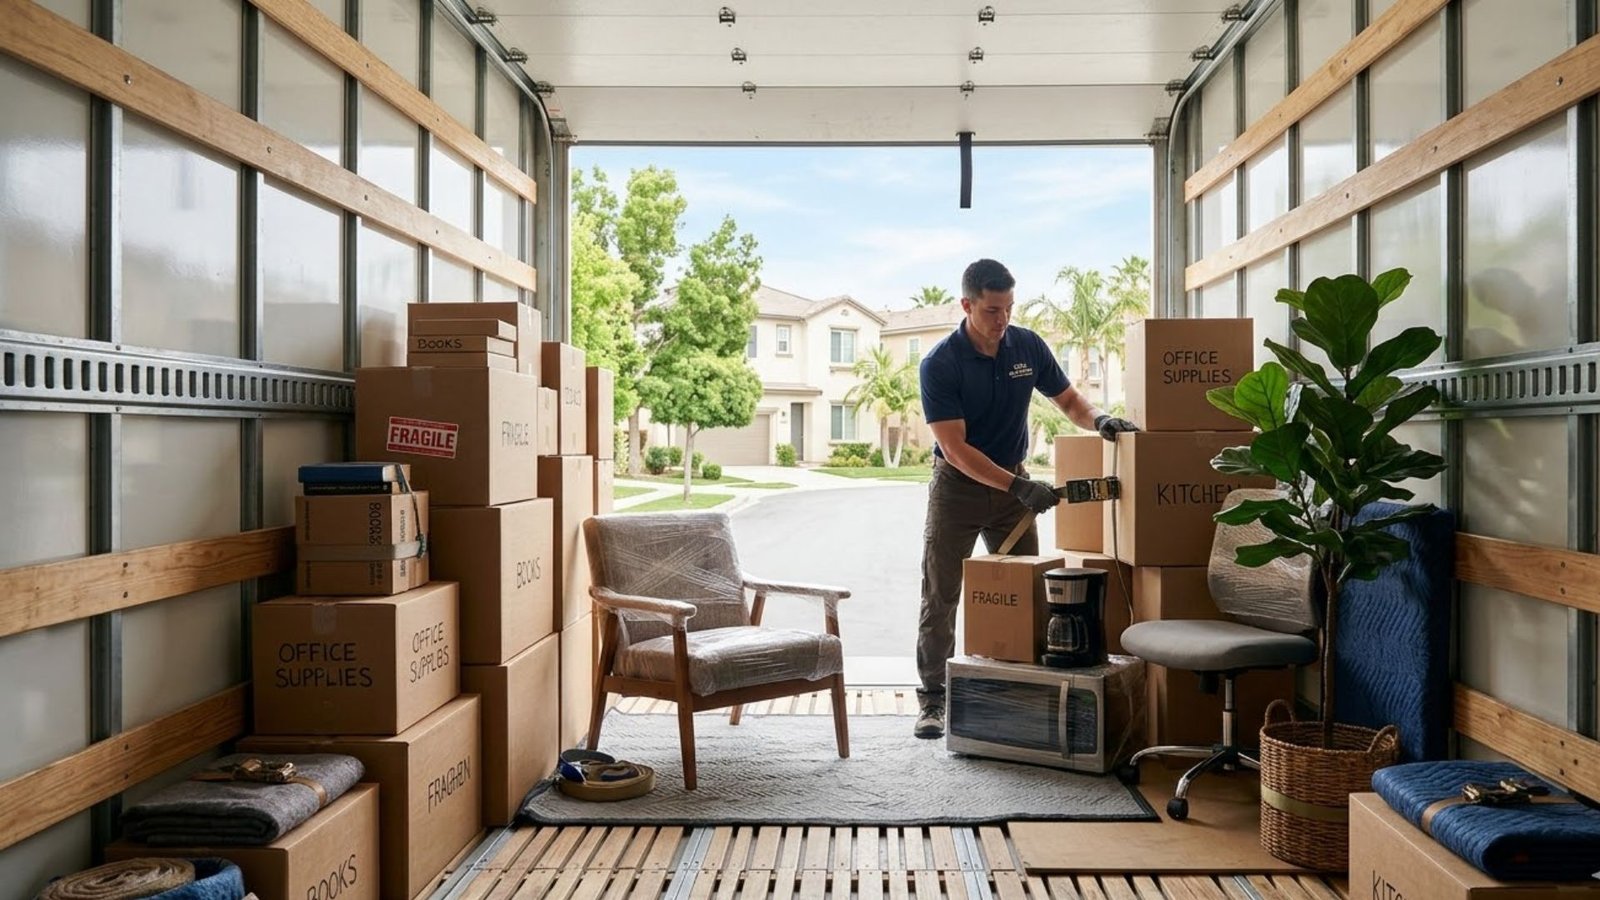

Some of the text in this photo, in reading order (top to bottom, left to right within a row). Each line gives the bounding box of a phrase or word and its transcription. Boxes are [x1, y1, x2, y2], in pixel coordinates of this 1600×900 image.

[417, 338, 463, 349] BOOKS
[1163, 350, 1218, 366] OFFICE
[1163, 368, 1232, 384] SUPPLIES
[390, 426, 455, 449] FRAGILE
[972, 590, 1018, 607] FRAGILE
[412, 621, 444, 653] OFFICE
[278, 642, 356, 663] OFFICE
[275, 667, 374, 688] SUPPLIES
